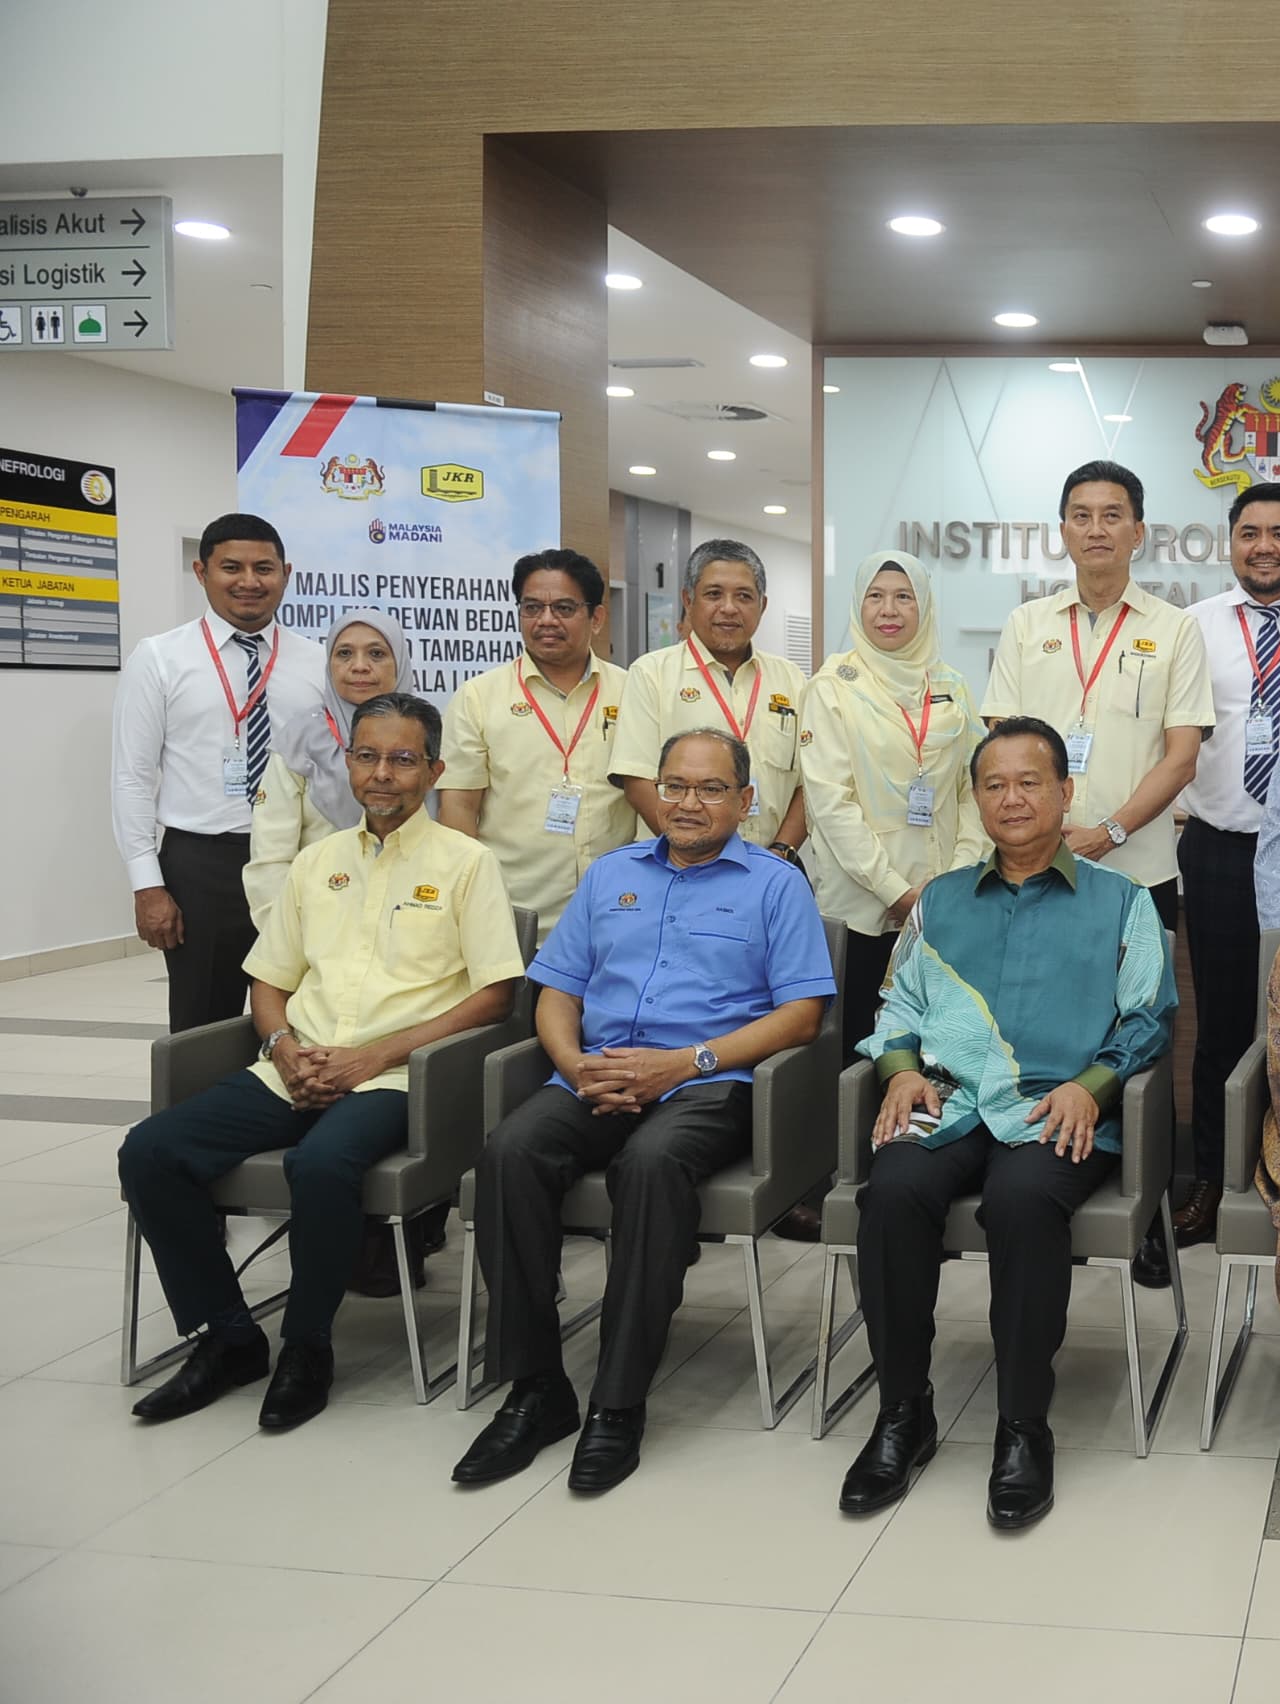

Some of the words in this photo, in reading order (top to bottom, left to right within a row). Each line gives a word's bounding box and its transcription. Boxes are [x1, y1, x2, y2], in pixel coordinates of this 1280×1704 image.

[55, 213, 105, 234] Akut
[24, 263, 105, 290] Logistik
[442, 471, 474, 483] JKR
[388, 523, 441, 532] MALAYSIA
[389, 532, 442, 543] MADANI
[899, 521, 1068, 560] INSTITU
[2, 577, 33, 589] KETUA
[37, 579, 75, 592] JABATAN
[295, 571, 370, 598] MAJLIS
[376, 574, 509, 602] PENYERAHAN
[466, 609, 521, 632] BEDA
